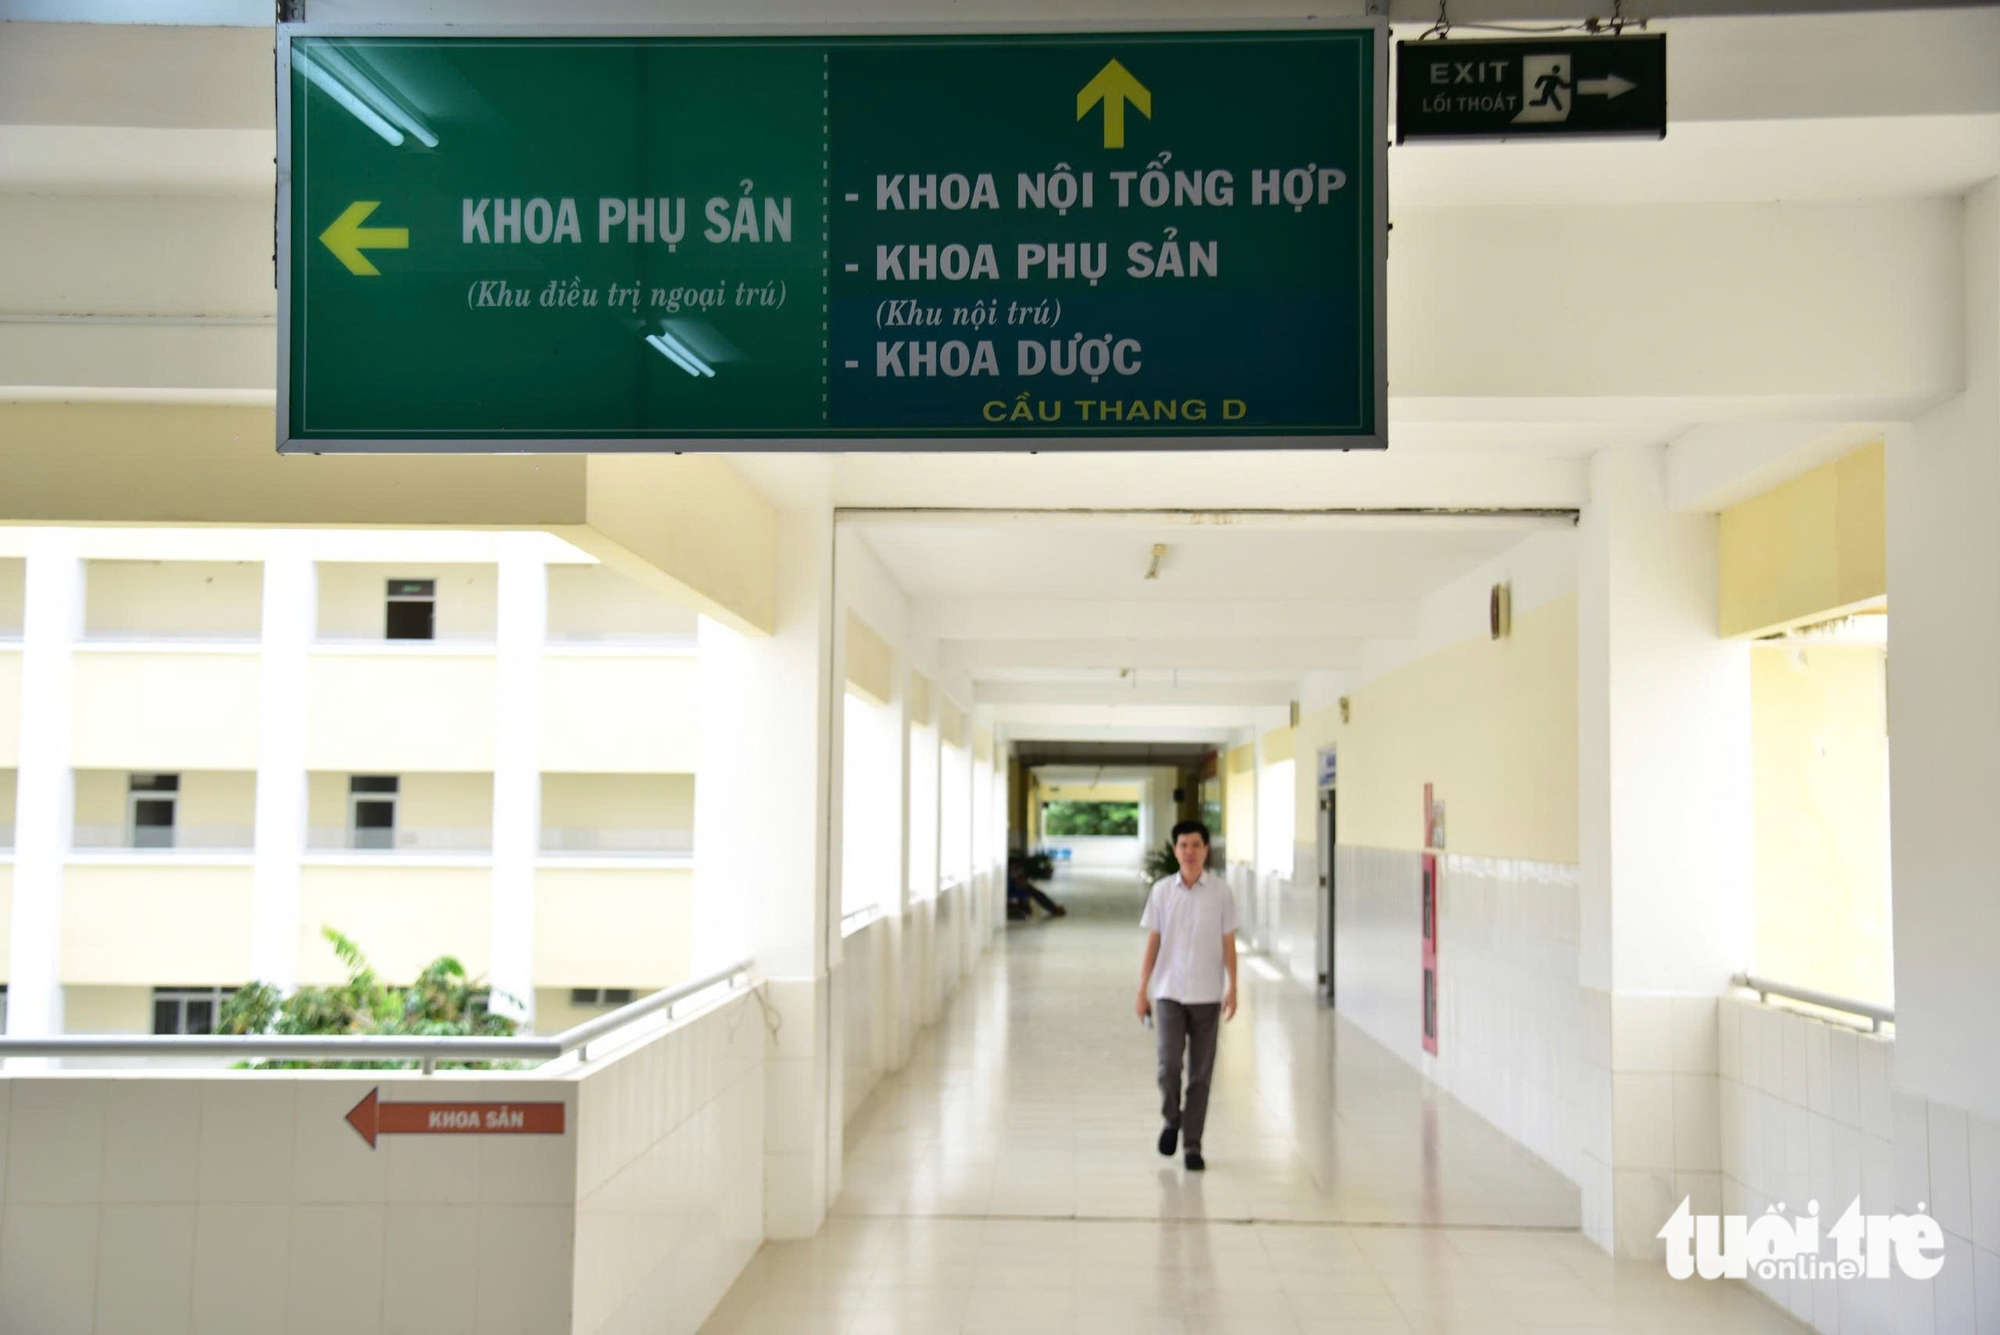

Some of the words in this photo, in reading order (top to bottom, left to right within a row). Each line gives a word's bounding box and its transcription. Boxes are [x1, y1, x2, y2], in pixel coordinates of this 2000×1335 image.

[1430, 61, 1509, 85] EXIT
[1422, 91, 1457, 113] LỐI
[1459, 91, 1517, 112] THOÁT
[876, 173, 999, 211] KHOA
[1017, 162, 1094, 216] NỘI
[1110, 151, 1234, 208] TỔNG
[1251, 163, 1347, 213] HỢP
[462, 197, 581, 244] KHOA
[598, 197, 686, 253] PHỤ
[703, 178, 792, 243] SẢN
[876, 244, 999, 281] KHOA
[1017, 243, 1108, 286] PHỤ
[1126, 227, 1218, 278] SẢN
[467, 280, 531, 310] (Khu
[539, 275, 599, 308] điều
[607, 279, 642, 313] trị
[650, 279, 726, 313] ngoại
[735, 278, 787, 310] trú)
[876, 299, 943, 330] (Khu
[952, 299, 998, 331] nội
[1006, 299, 1062, 328] trú)
[876, 341, 999, 377] KHOA
[1017, 333, 1142, 383] DƯỢC
[982, 391, 1062, 422] CẦU
[1074, 398, 1207, 421] THANG
[1222, 399, 1247, 420] D
[428, 1110, 481, 1129] KHOA
[485, 1104, 524, 1129] SẢN
